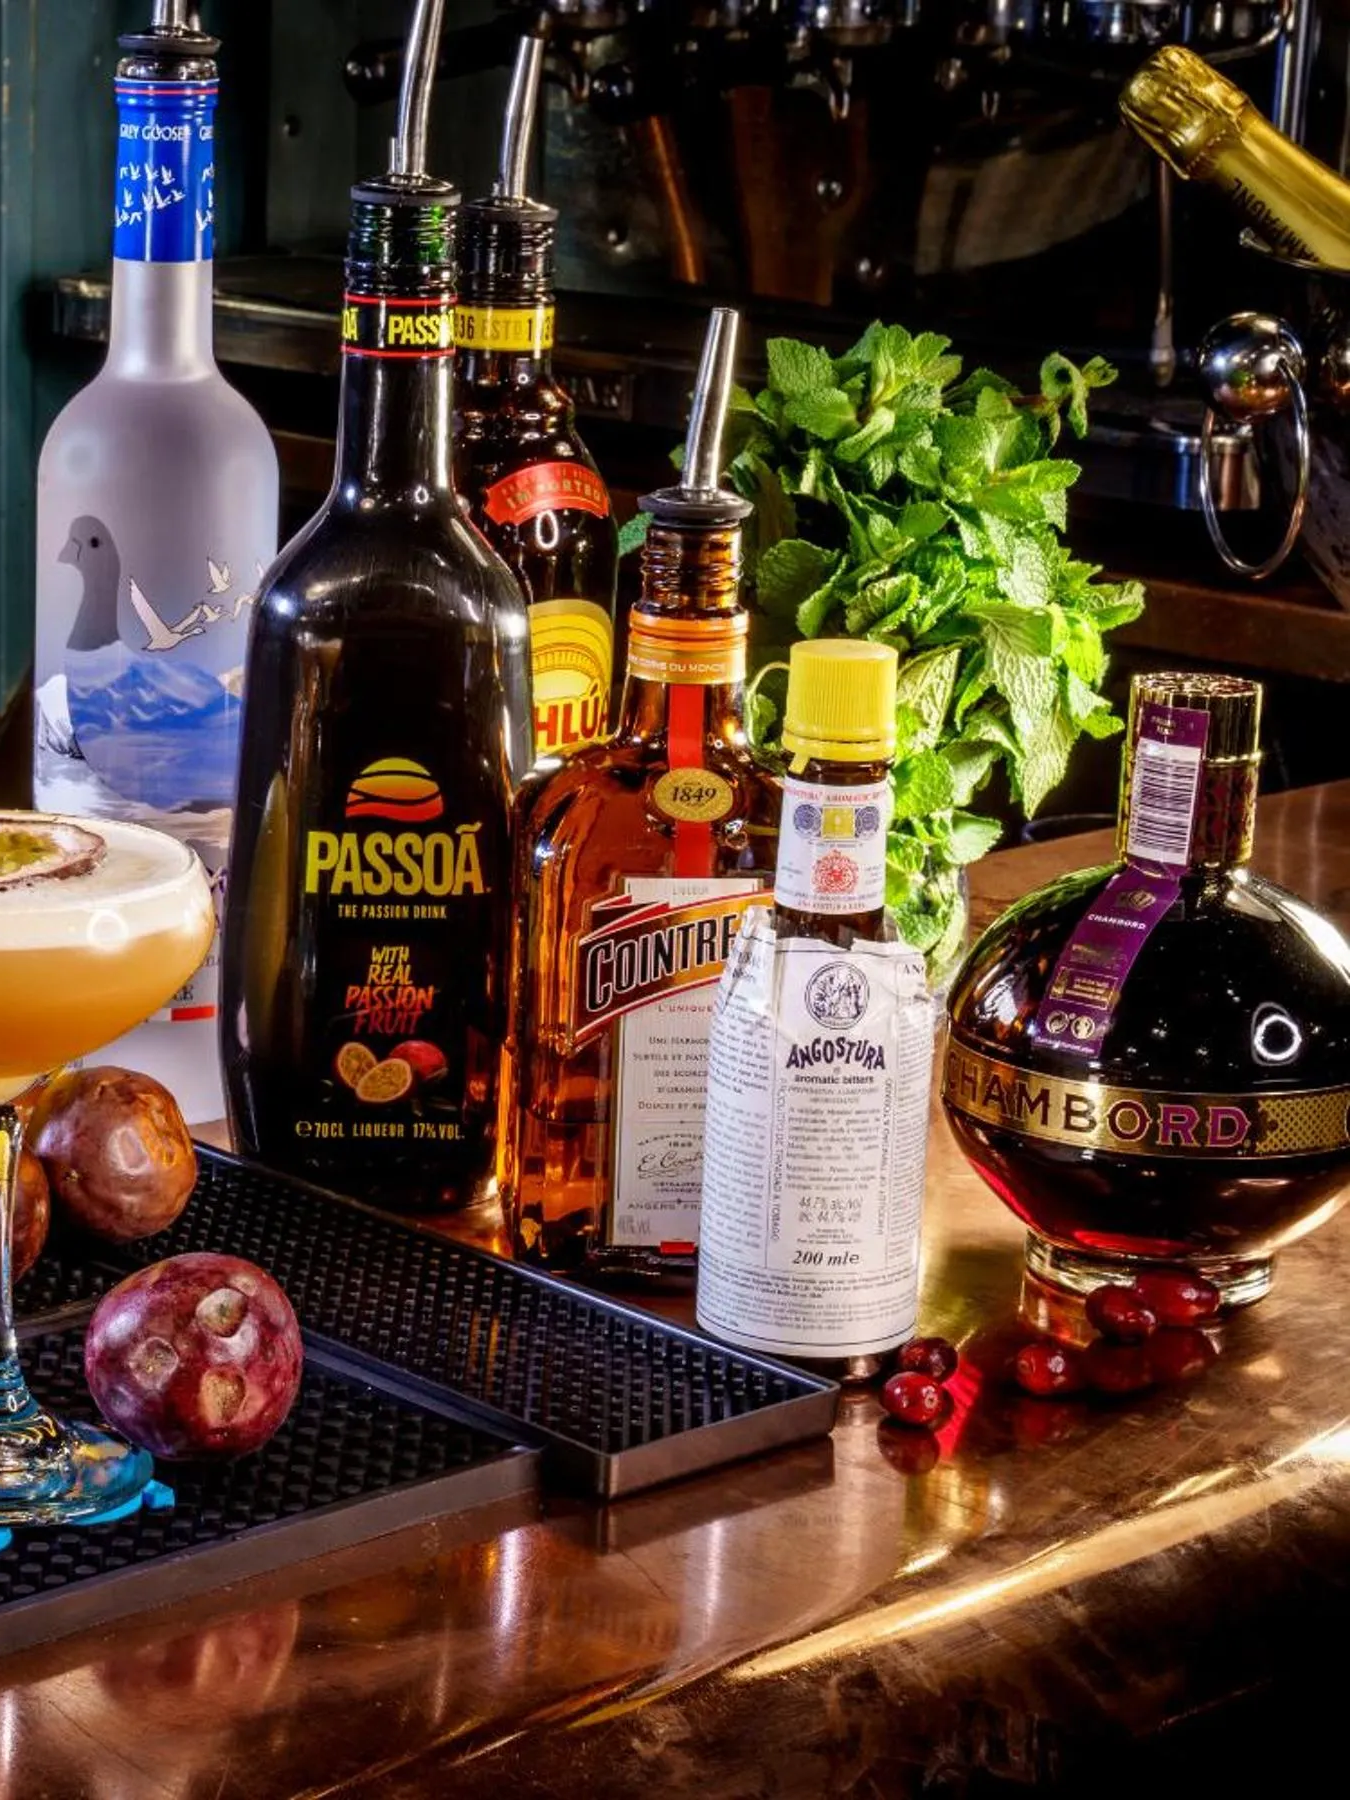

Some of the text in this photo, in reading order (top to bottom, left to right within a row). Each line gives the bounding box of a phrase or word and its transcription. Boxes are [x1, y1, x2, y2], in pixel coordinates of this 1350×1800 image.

[141, 124, 186, 141] GOOSE
[672, 786, 717, 802] 1849
[305, 821, 485, 897] PASSOÃ
[338, 904, 448, 920] THE PASSION DRINK
[1087, 913, 1147, 931] CHAMBORD
[371, 945, 410, 964] WITH
[367, 964, 413, 985] REAL
[345, 984, 436, 1010] PASSION
[353, 1007, 426, 1035] FRUIT
[786, 1036, 886, 1070] ANGOSTURA
[794, 1074, 874, 1084] aromatic bitters
[353, 1123, 405, 1139] LIQUEUR
[792, 1250, 824, 1266] 200
